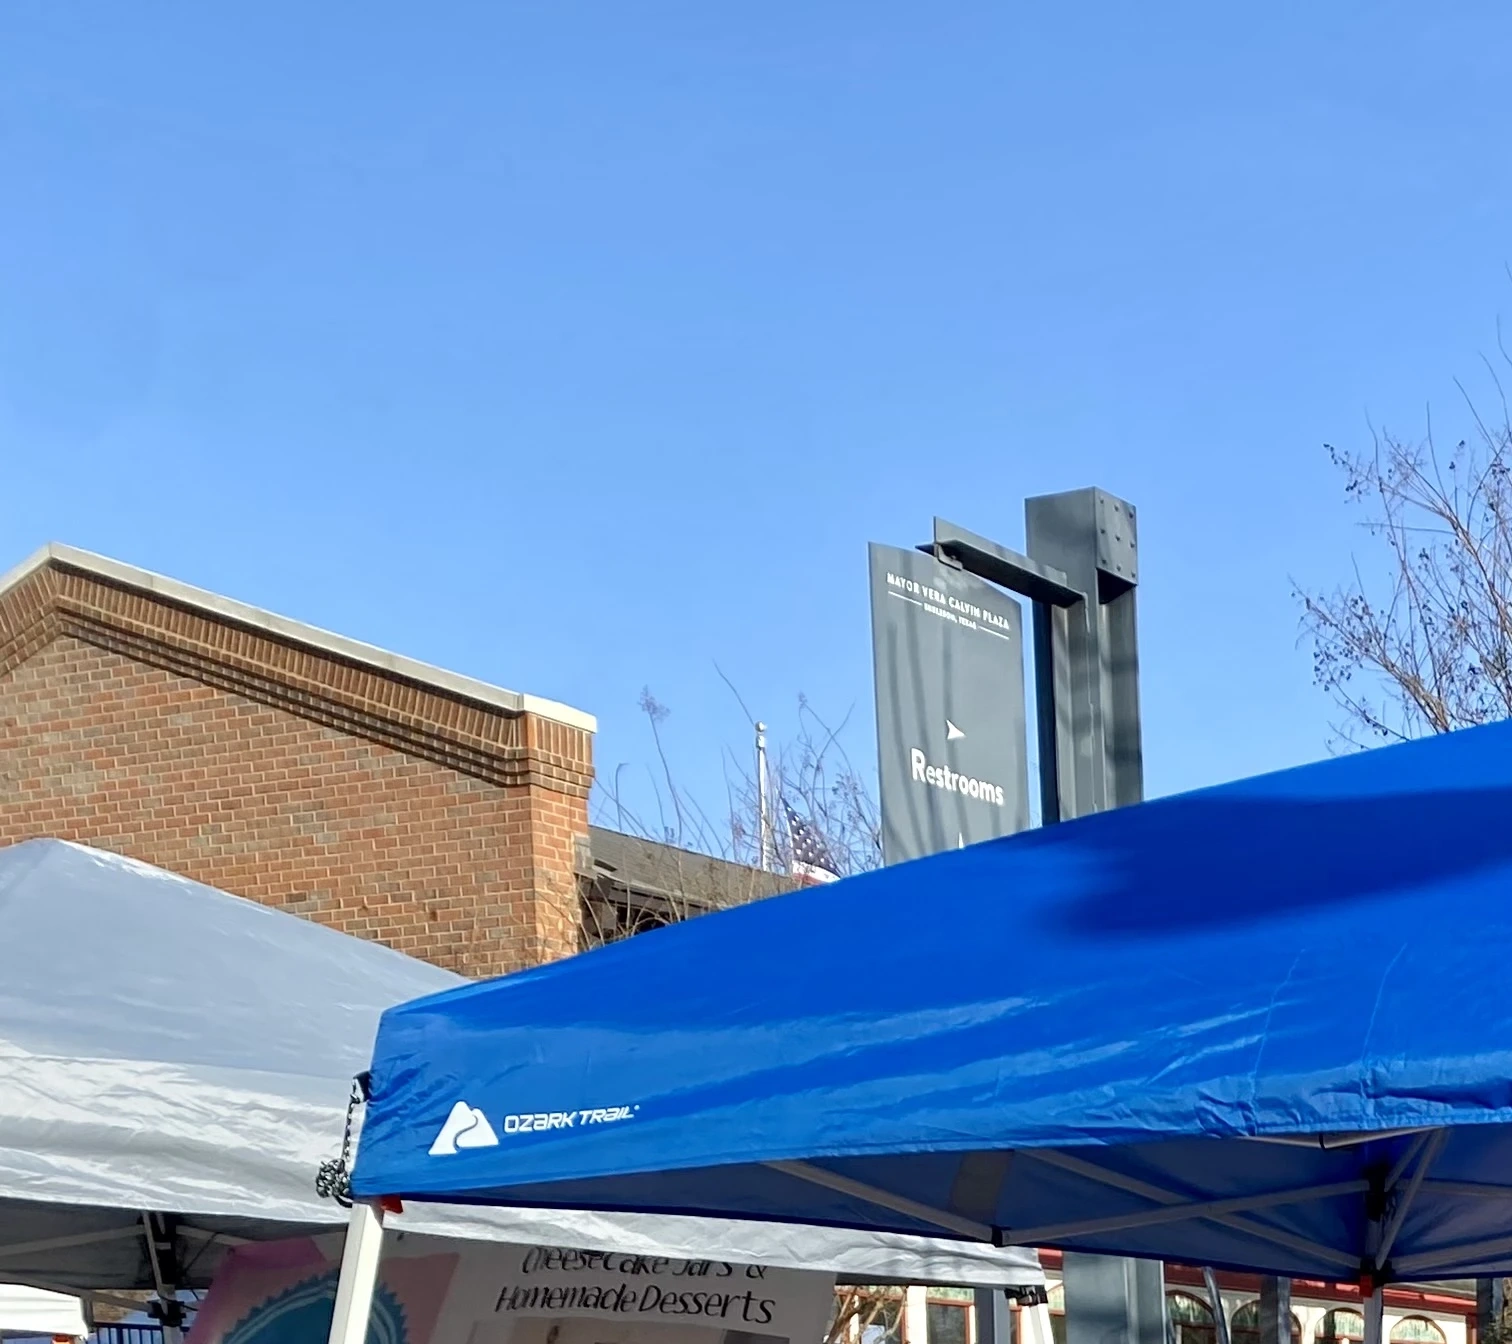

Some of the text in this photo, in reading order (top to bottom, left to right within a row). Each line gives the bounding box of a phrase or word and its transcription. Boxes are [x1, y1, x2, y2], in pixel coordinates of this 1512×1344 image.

[886, 572, 1010, 630] MAYOR VERA CALVIN PLAZA
[911, 747, 1004, 806] Restrooms
[504, 1106, 635, 1133] OZARK TRAIL
[494, 1283, 776, 1324] Homemade Desserts
